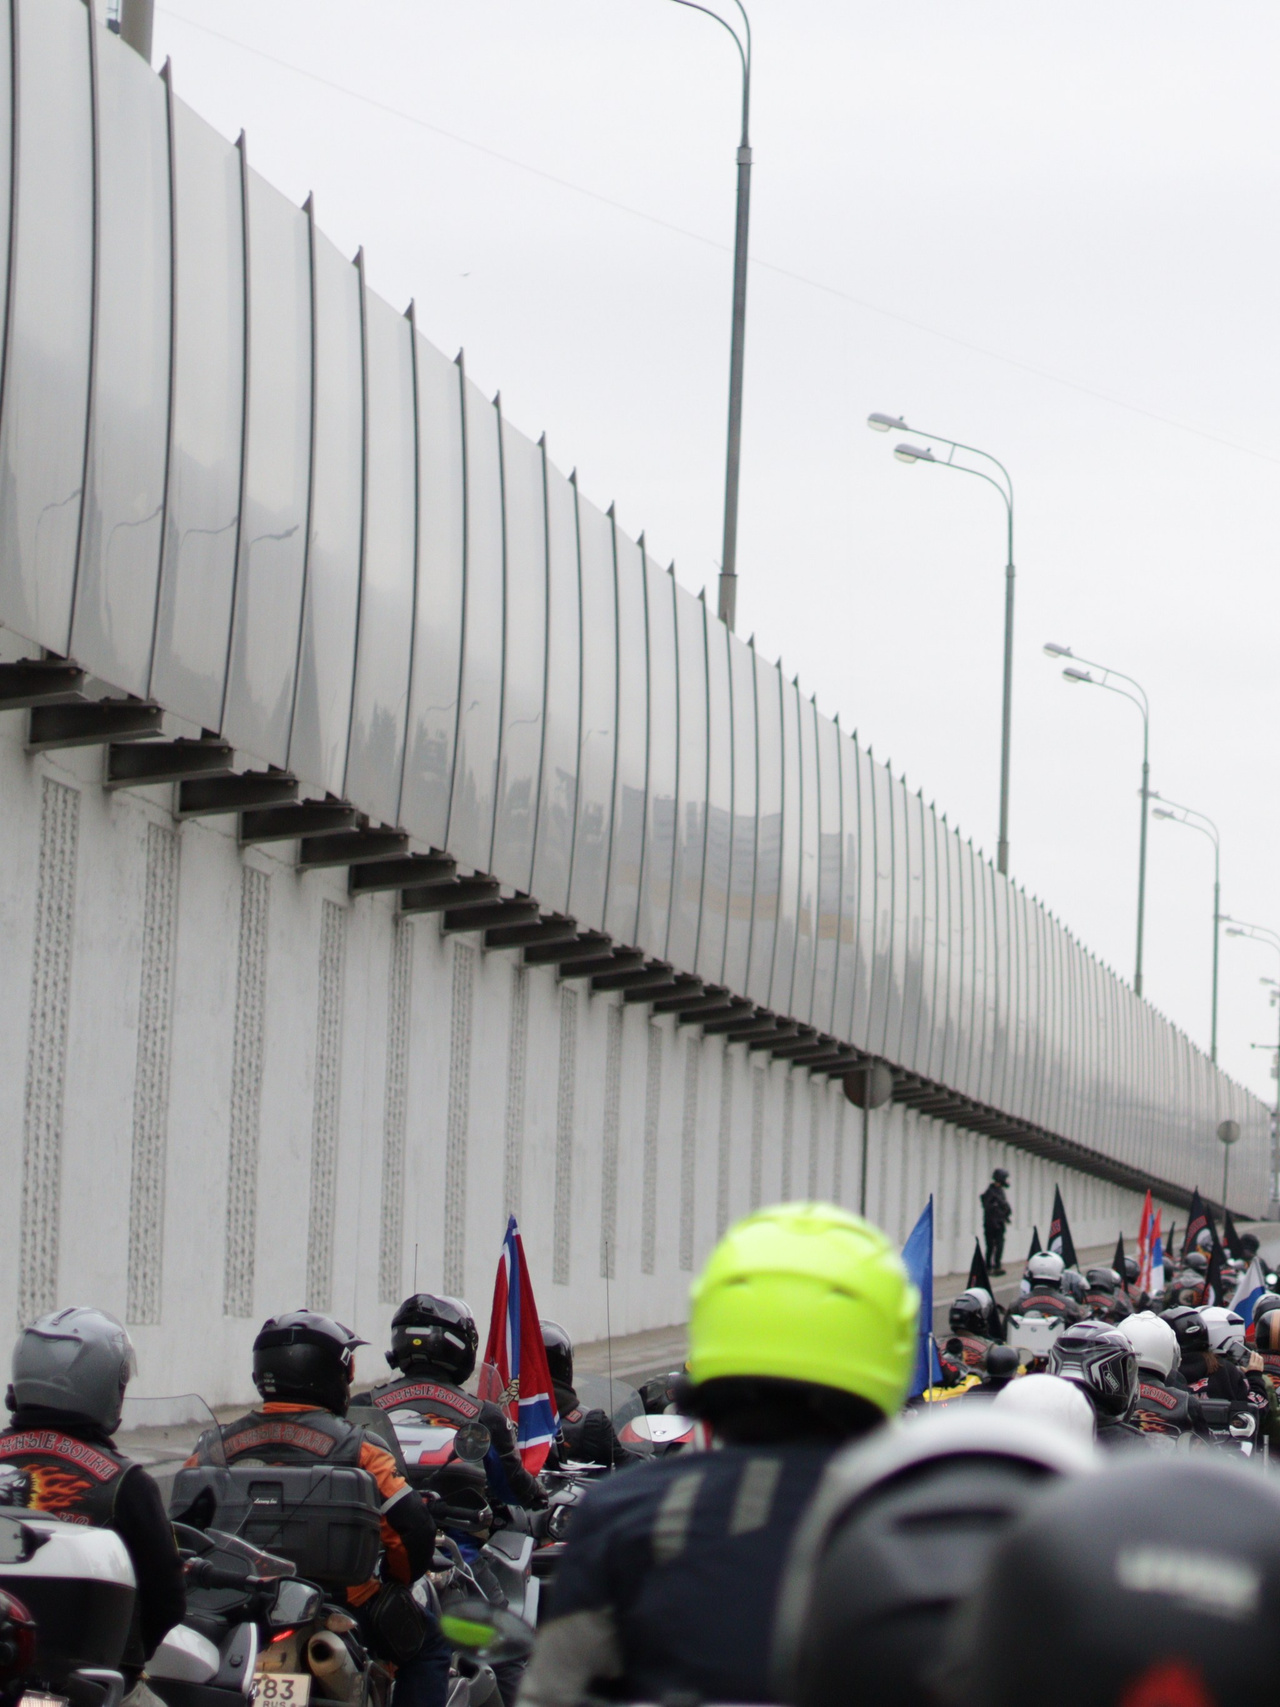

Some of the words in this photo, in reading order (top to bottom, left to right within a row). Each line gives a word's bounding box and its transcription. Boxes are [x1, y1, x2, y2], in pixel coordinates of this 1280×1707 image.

[378, 1385, 434, 1408] НОЧНЫЕ
[435, 1388, 478, 1416] ВОЛКИ
[57, 1438, 118, 1480] ВОЛКИ
